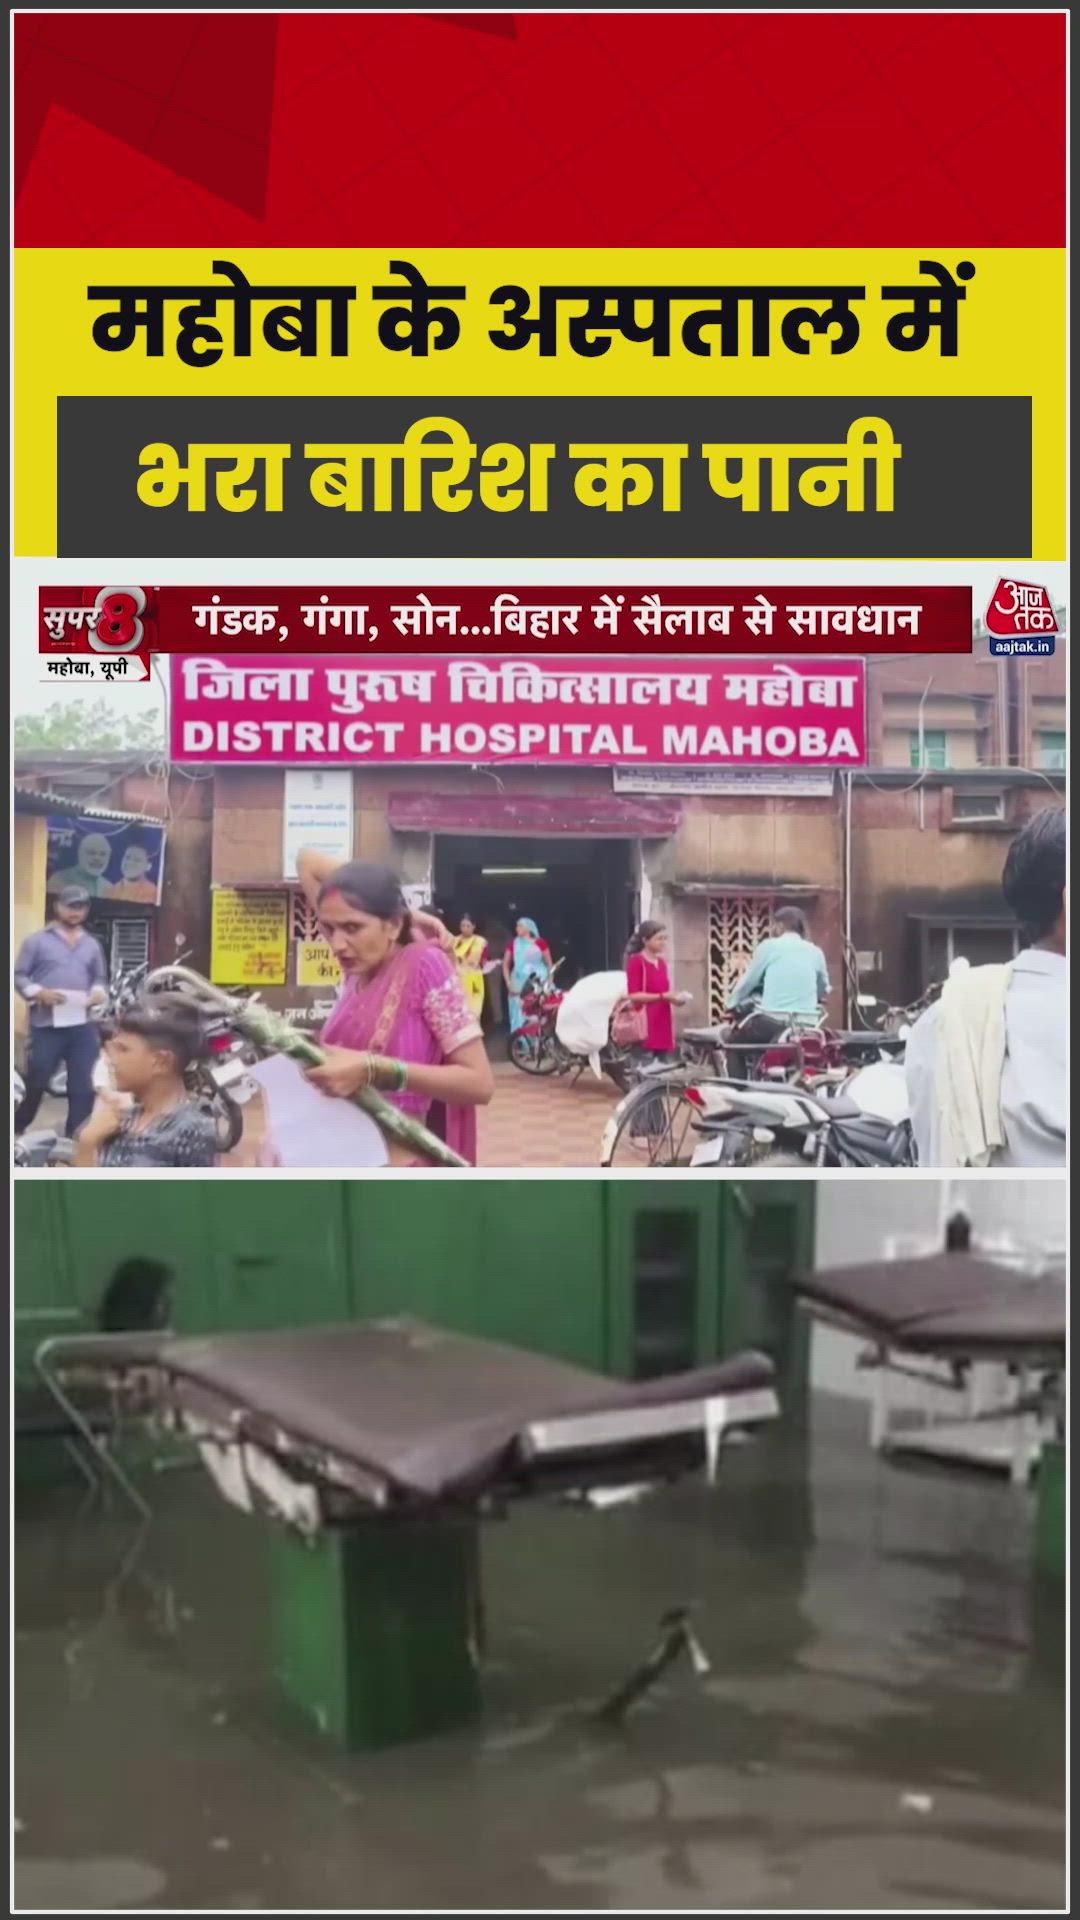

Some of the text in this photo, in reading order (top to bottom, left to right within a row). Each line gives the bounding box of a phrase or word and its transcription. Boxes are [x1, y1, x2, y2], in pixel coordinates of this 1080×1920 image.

[182, 657, 314, 701] जिला
[448, 661, 712, 706] चिकित्सालय
[722, 663, 858, 708] महोबा
[183, 721, 859, 758] DISTRICT HOSPITAL MAHOBA
